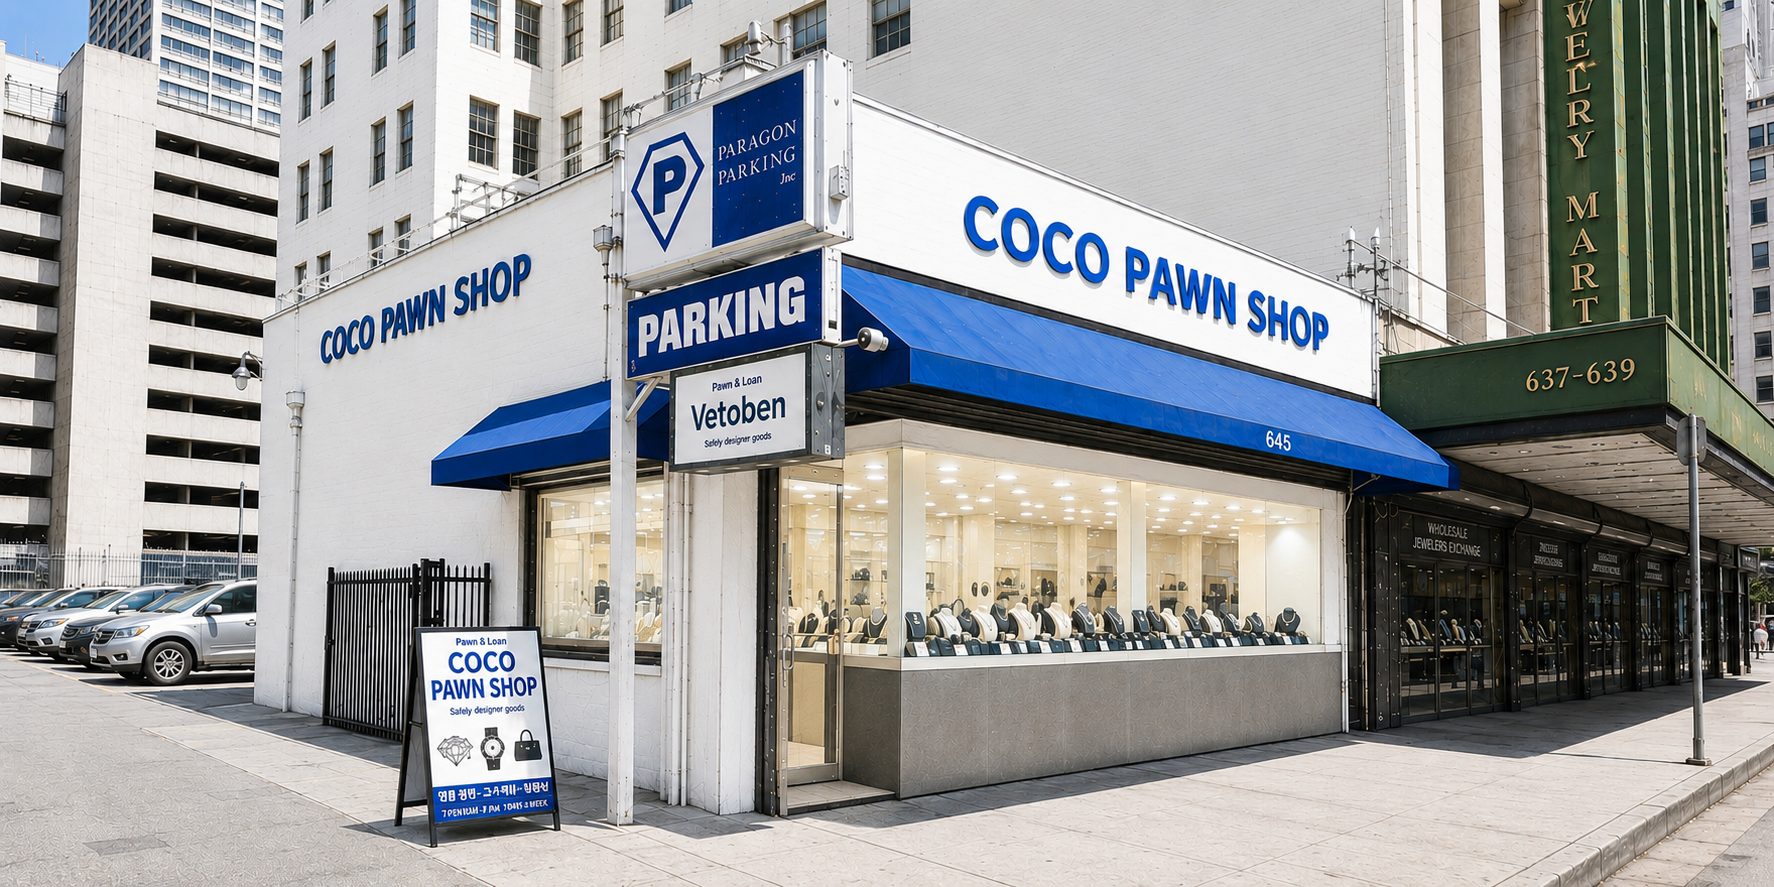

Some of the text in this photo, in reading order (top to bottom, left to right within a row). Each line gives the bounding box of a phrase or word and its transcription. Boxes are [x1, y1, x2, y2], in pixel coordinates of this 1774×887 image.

[718, 119, 797, 161] PARAGON
[718, 146, 796, 186] PARKING
[653, 155, 687, 216] P
[1565, 191, 1600, 324] MART
[963, 195, 1329, 351] COCO PAWN SHOP
[320, 253, 532, 364] COCO PAWN SHOP
[638, 275, 806, 358] PARKING
[712, 374, 762, 392] Pawn & Loan
[1526, 358, 1635, 392] 637-639
[691, 395, 786, 431] Vetoben
[751, 431, 772, 443] goods
[1266, 430, 1291, 451] 645
[1412, 536, 1448, 552] JEWELERS
[1427, 522, 1468, 539] WHOLESALE
[455, 637, 507, 646] Pawn & Loan
[448, 650, 516, 674] COCO
[431, 676, 537, 701] PAWN SHOP
[474, 705, 503, 715] designer
[505, 704, 525, 715] goods
